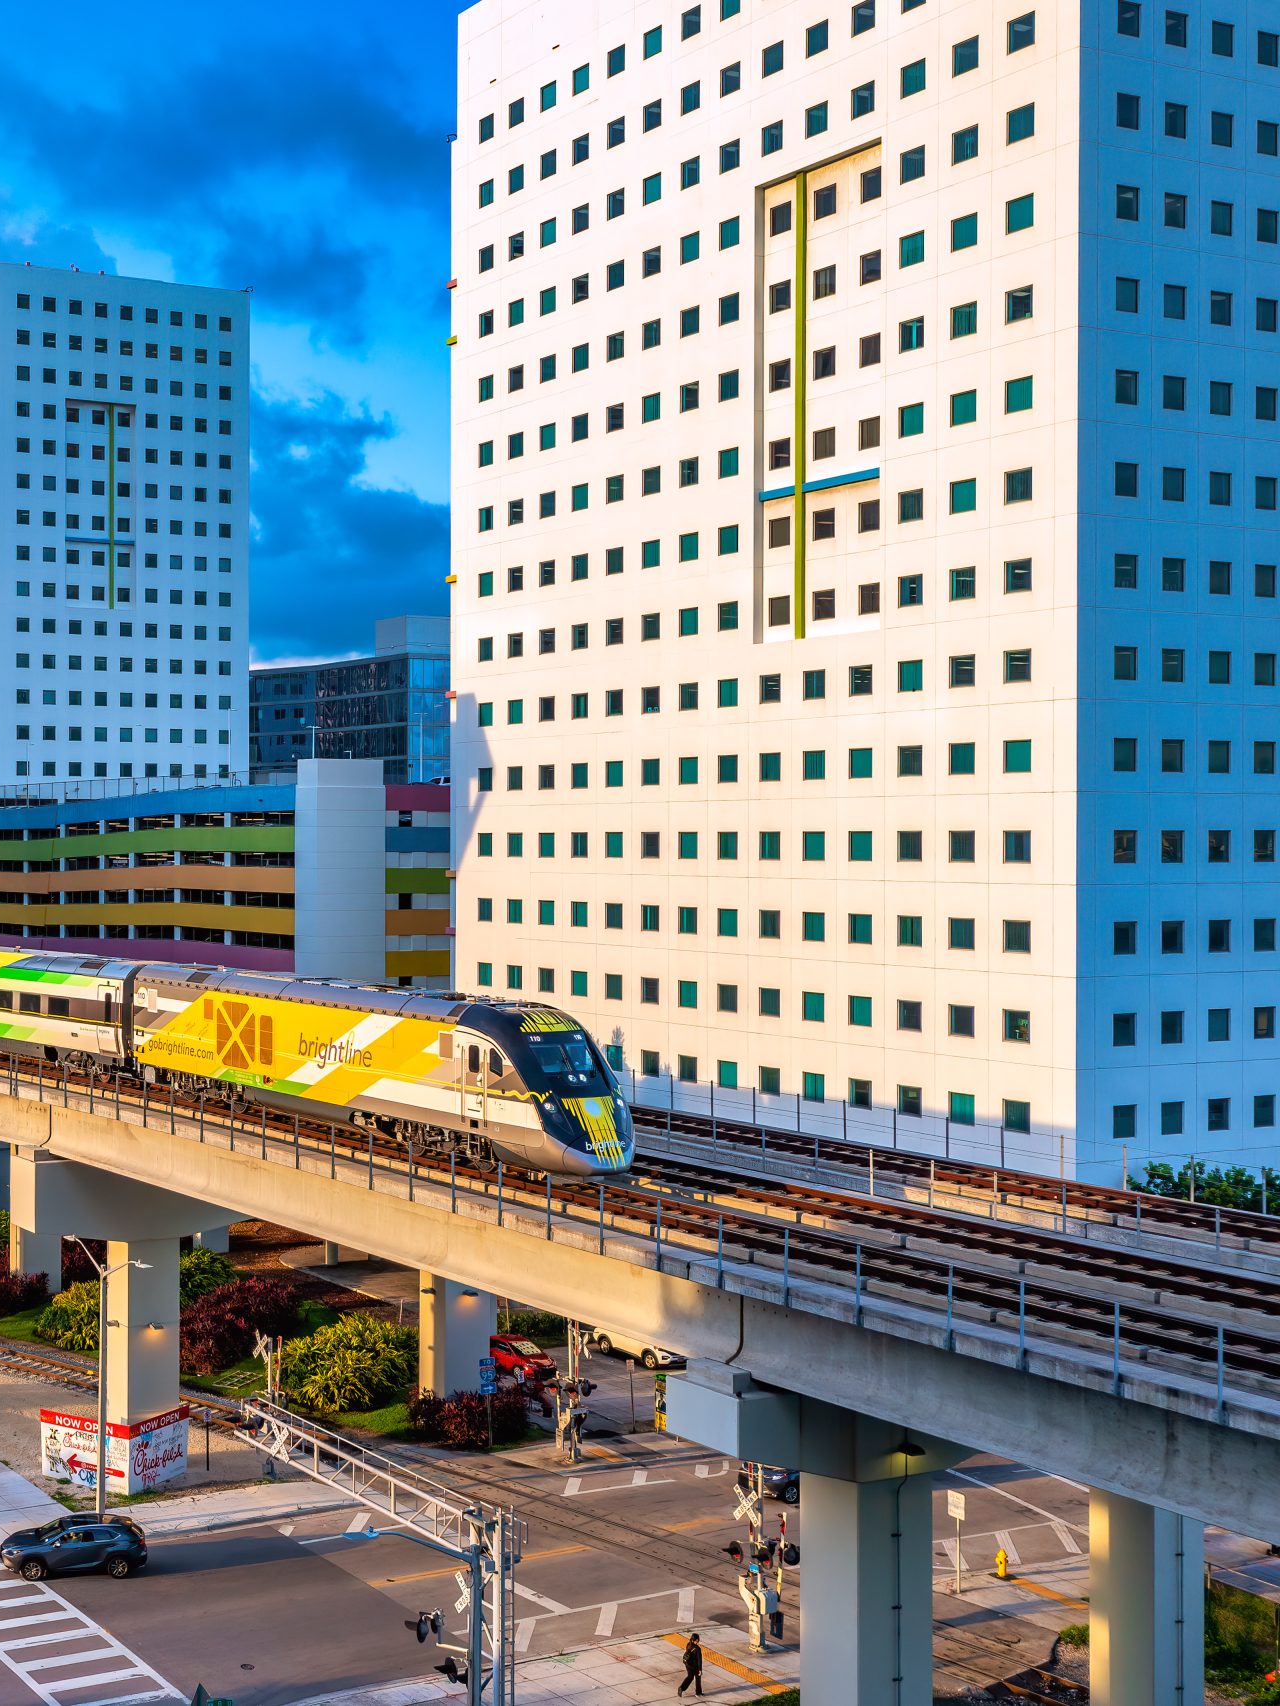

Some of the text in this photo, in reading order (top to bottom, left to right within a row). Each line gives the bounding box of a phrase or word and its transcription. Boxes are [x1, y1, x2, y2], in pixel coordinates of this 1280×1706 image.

[148, 1038, 214, 1061] gobrightline.com
[298, 1032, 372, 1069] brightline
[585, 1138, 626, 1153] brightline
[481, 1370, 493, 1380] 95
[55, 1415, 81, 1429] NOW
[84, 1422, 114, 1435] OPN
[140, 1411, 180, 1433] NOW OPEN
